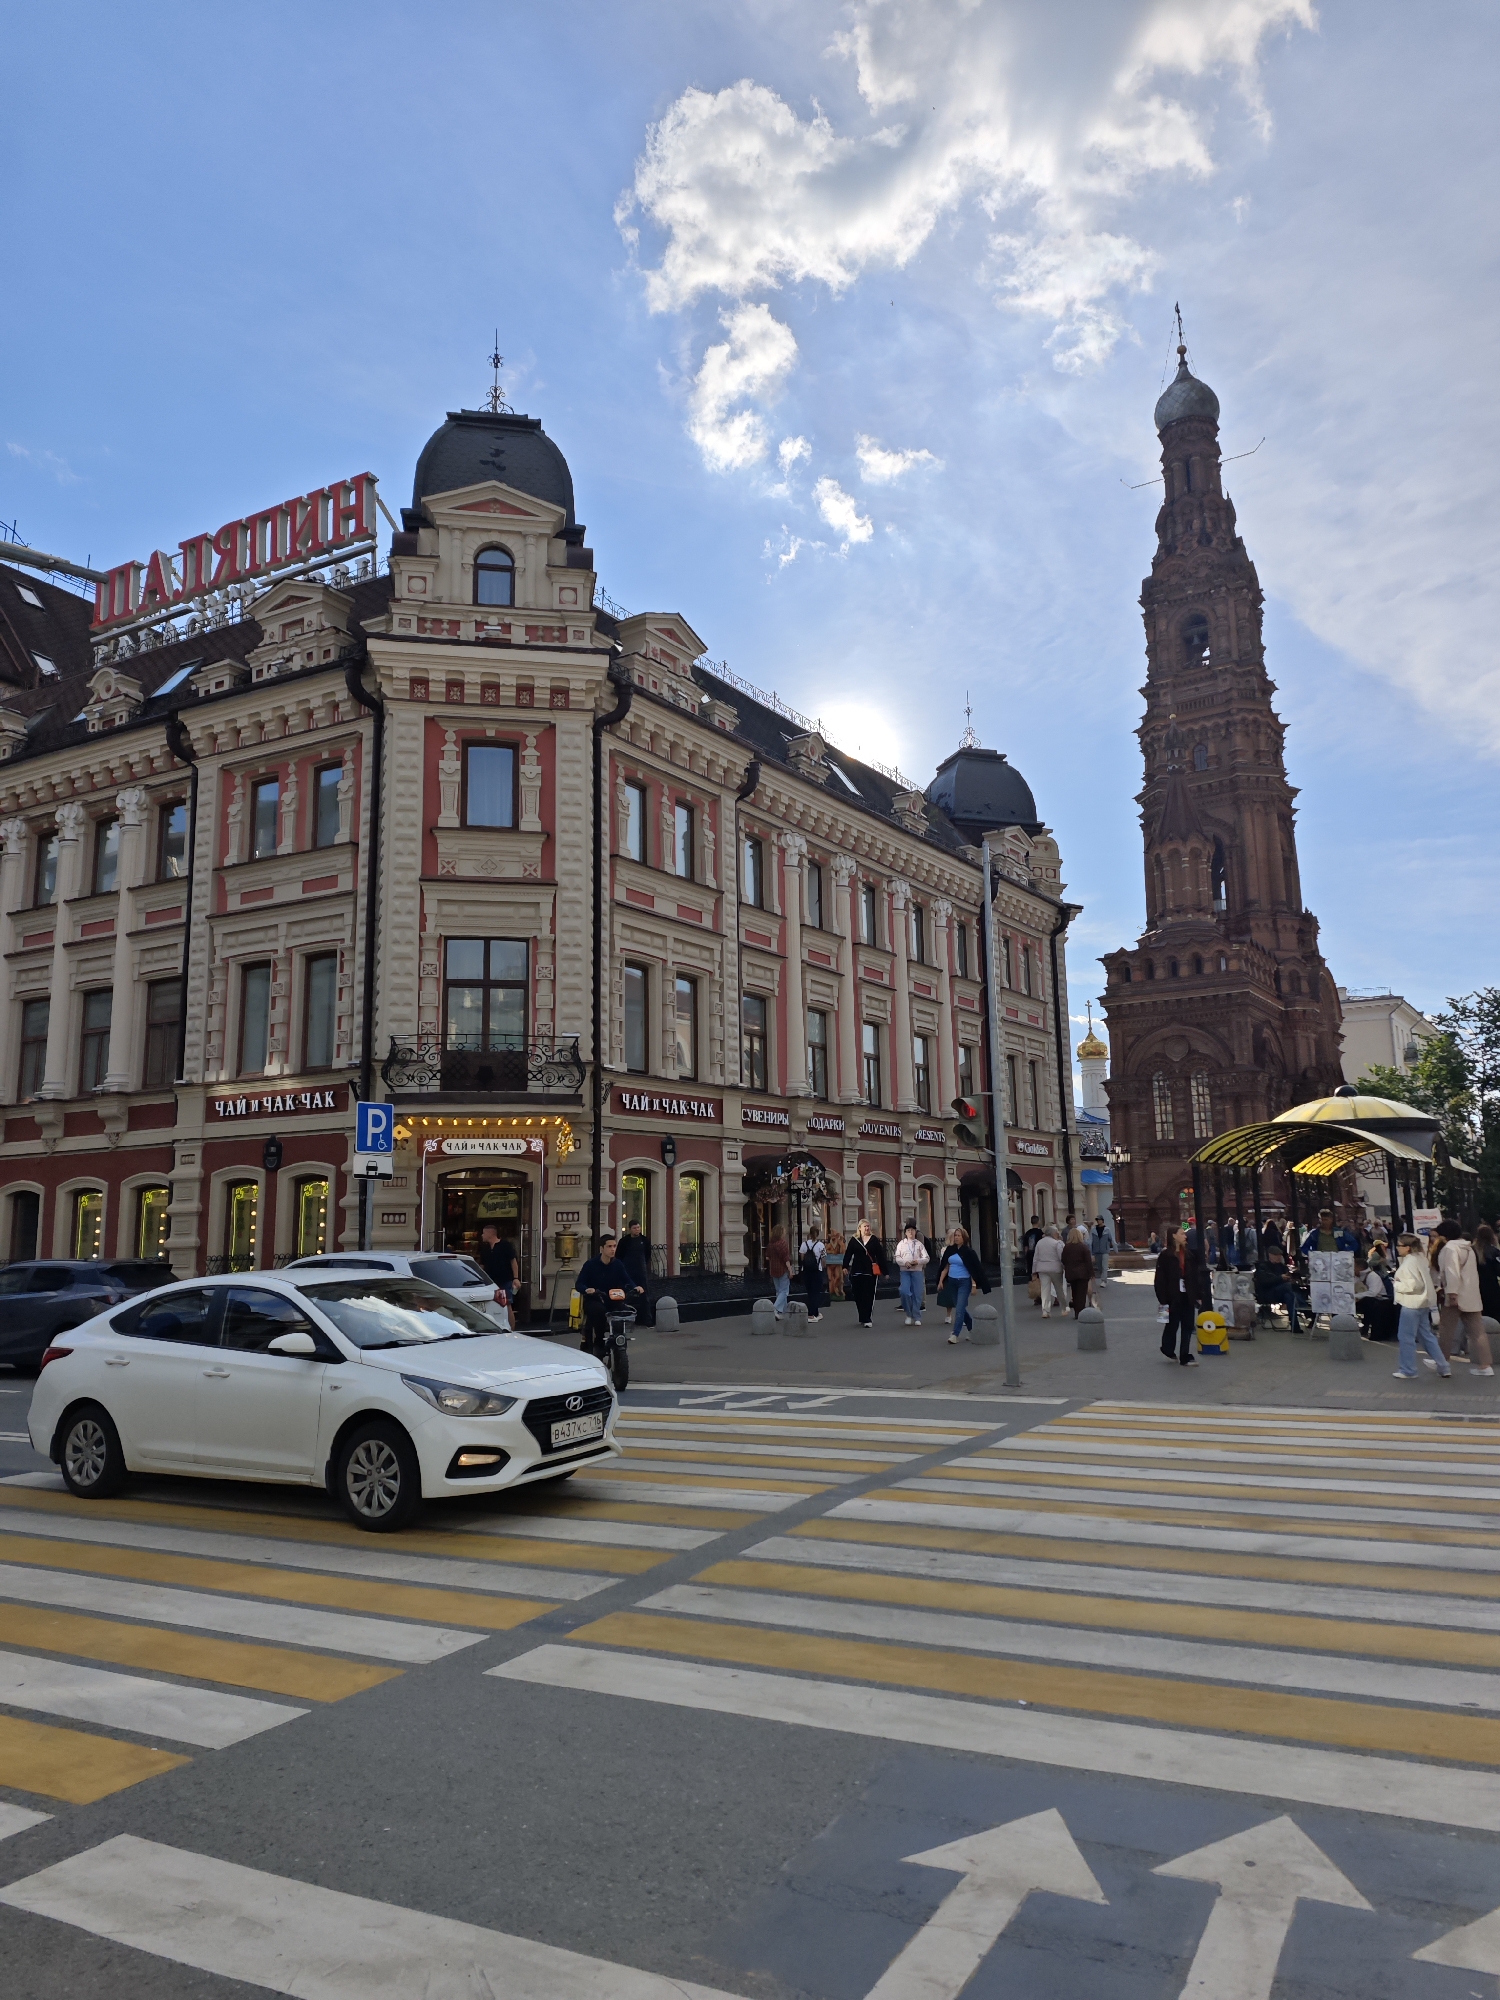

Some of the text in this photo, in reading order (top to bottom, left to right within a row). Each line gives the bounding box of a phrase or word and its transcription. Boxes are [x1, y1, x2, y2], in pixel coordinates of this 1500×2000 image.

[90, 471, 378, 632] ШАЛЯПИН
[215, 1095, 247, 1117] ЧАЙ
[622, 1091, 649, 1112] ЧАЙ
[367, 1108, 387, 1147] P
[741, 1108, 790, 1126] СУВЕНИРЫ
[807, 1117, 845, 1132] ПОДАРКИ
[446, 1141, 468, 1151] ЧАЙ
